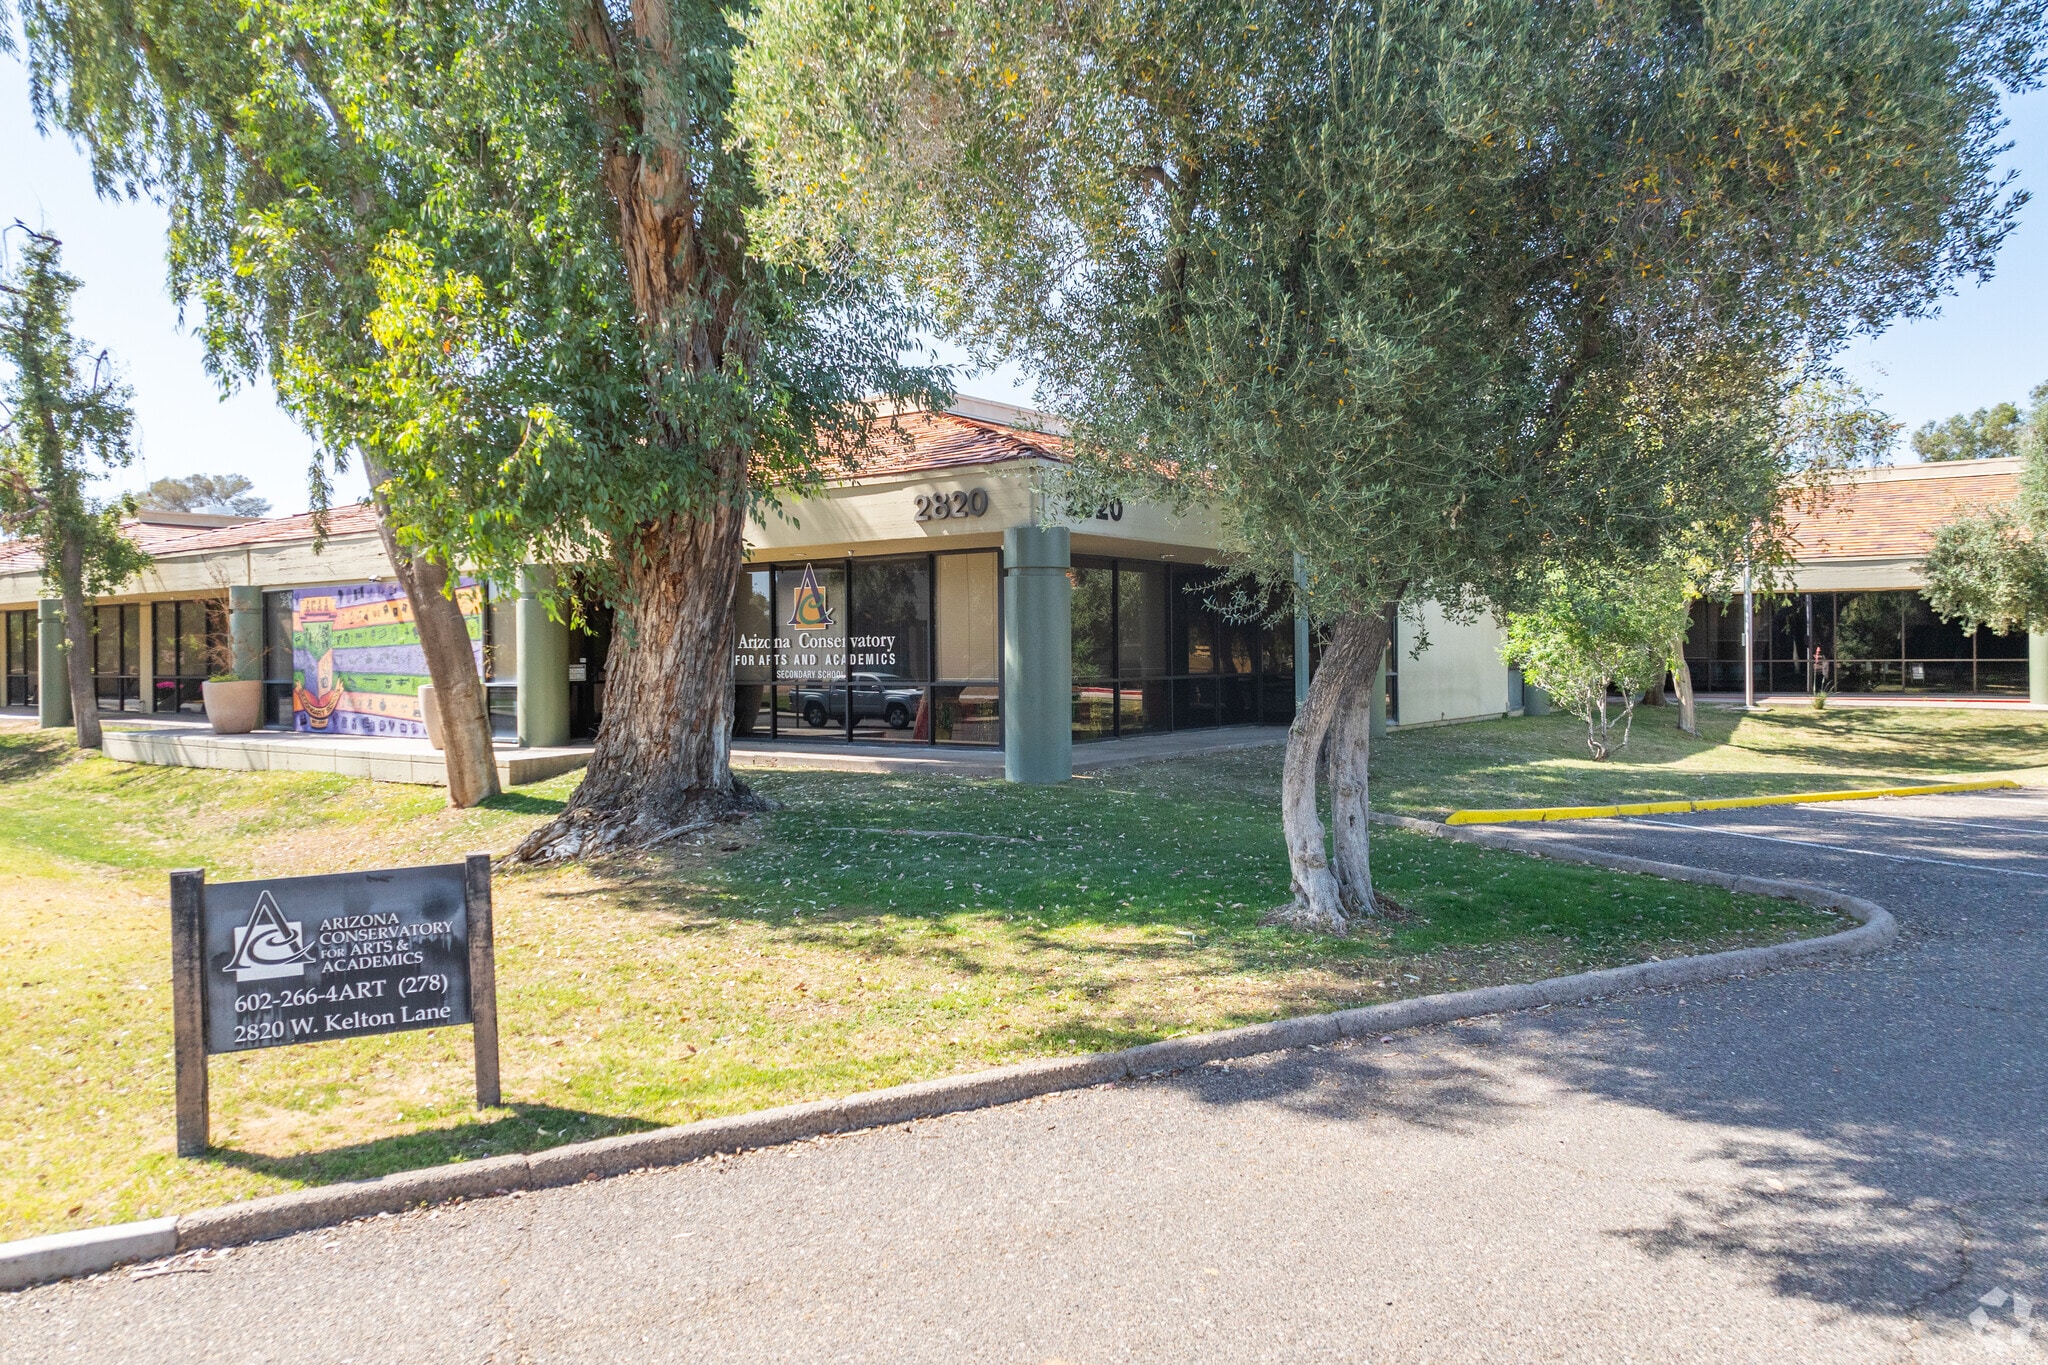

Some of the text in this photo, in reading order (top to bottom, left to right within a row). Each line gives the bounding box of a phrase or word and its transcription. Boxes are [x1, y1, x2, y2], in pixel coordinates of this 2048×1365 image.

[914, 487, 988, 522] 2820
[737, 633, 895, 652] Arizona Conservatory
[735, 654, 755, 666] FOR
[794, 654, 816, 665] AND
[825, 653, 896, 666] ACADEMICS
[776, 670, 815, 679] SECONDARY
[319, 913, 399, 931] ARIZONA
[319, 921, 454, 946] CONSERVATORY
[321, 939, 410, 959] FOR ARTS &
[321, 951, 424, 974] ACADEMICS
[234, 973, 449, 1013] 602-266-4ART (278)
[234, 1005, 451, 1043] 2820 W. Kelton Lane
